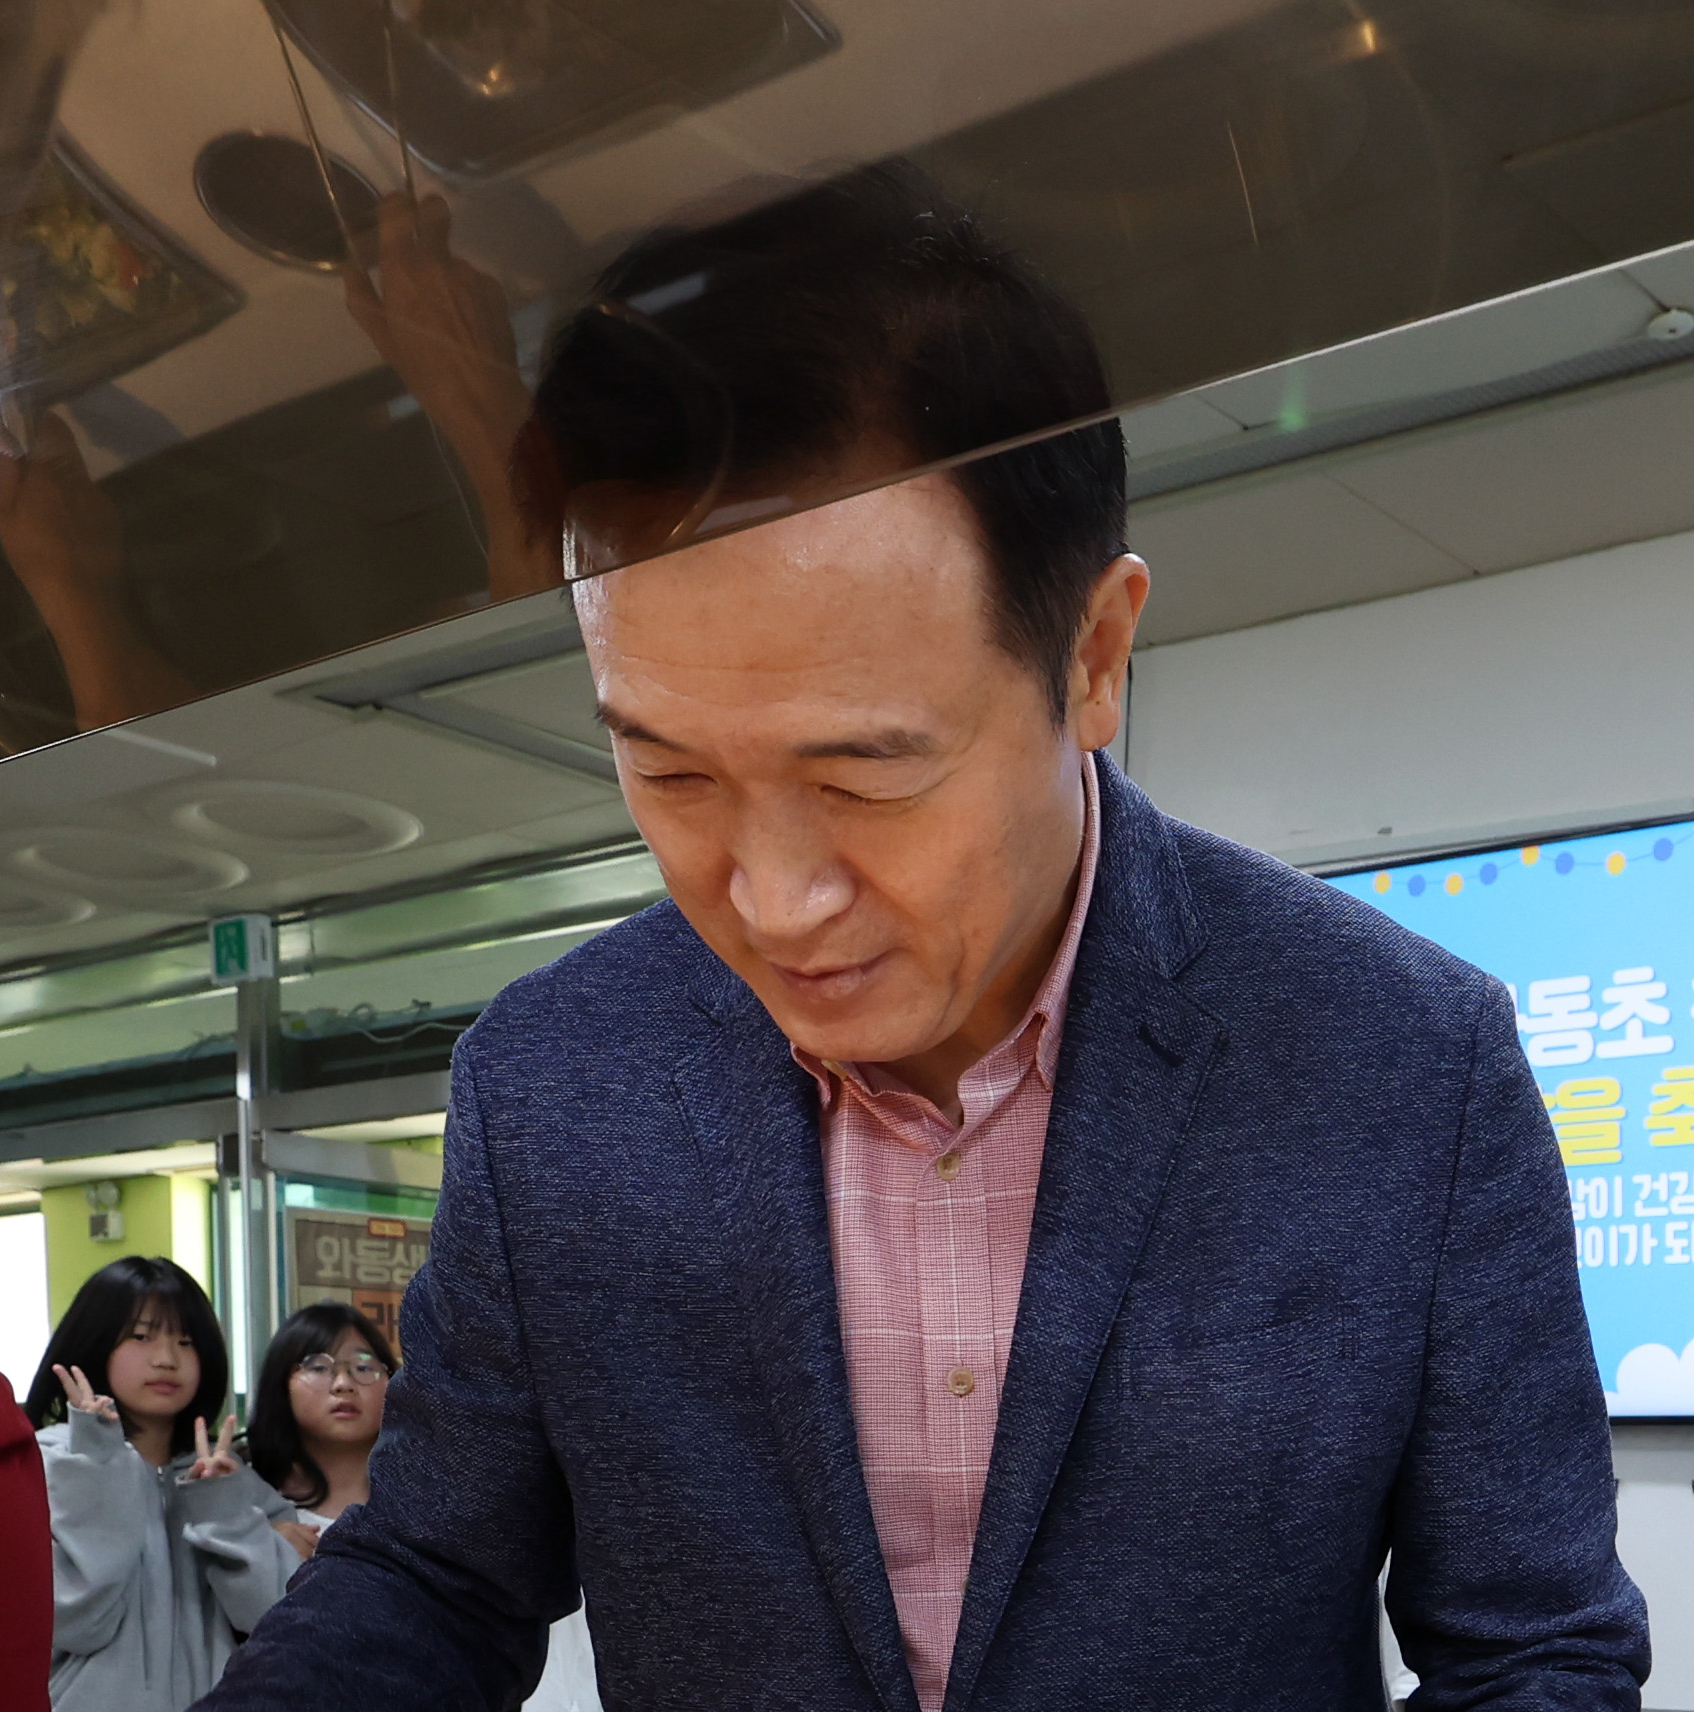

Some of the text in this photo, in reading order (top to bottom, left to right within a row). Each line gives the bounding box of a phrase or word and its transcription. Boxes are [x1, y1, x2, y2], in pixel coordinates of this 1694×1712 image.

[1506, 966, 1674, 1067] 동초
[1539, 1077, 1626, 1166] 을
[1576, 1222, 1657, 1269] 이가
